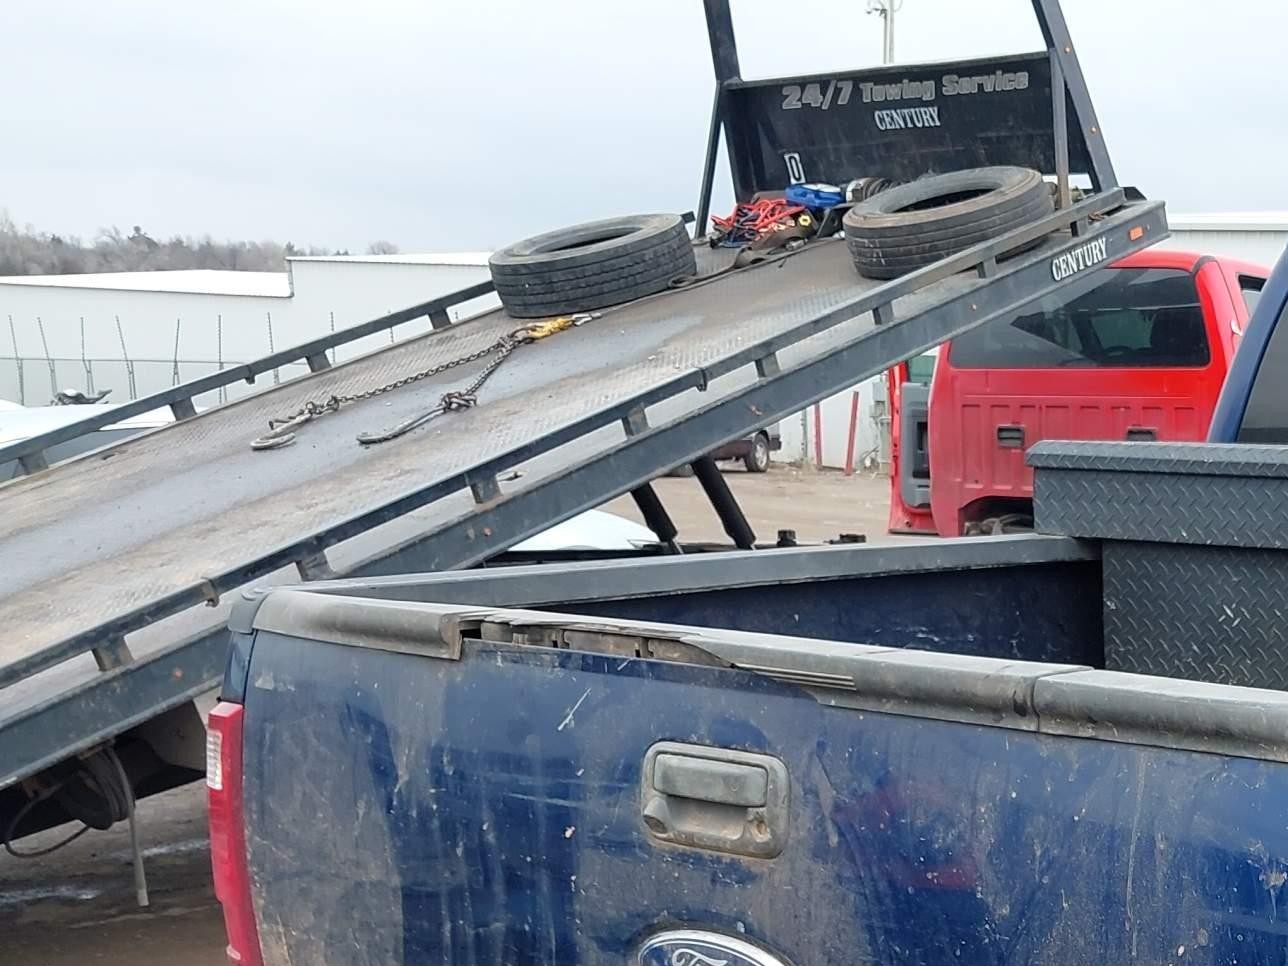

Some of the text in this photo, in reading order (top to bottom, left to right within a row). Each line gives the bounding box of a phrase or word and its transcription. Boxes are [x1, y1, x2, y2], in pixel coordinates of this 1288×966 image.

[782, 69, 1029, 110] 24/7 Towing Service
[874, 106, 941, 130] CENTURY
[1052, 236, 1107, 281] CENTURY
